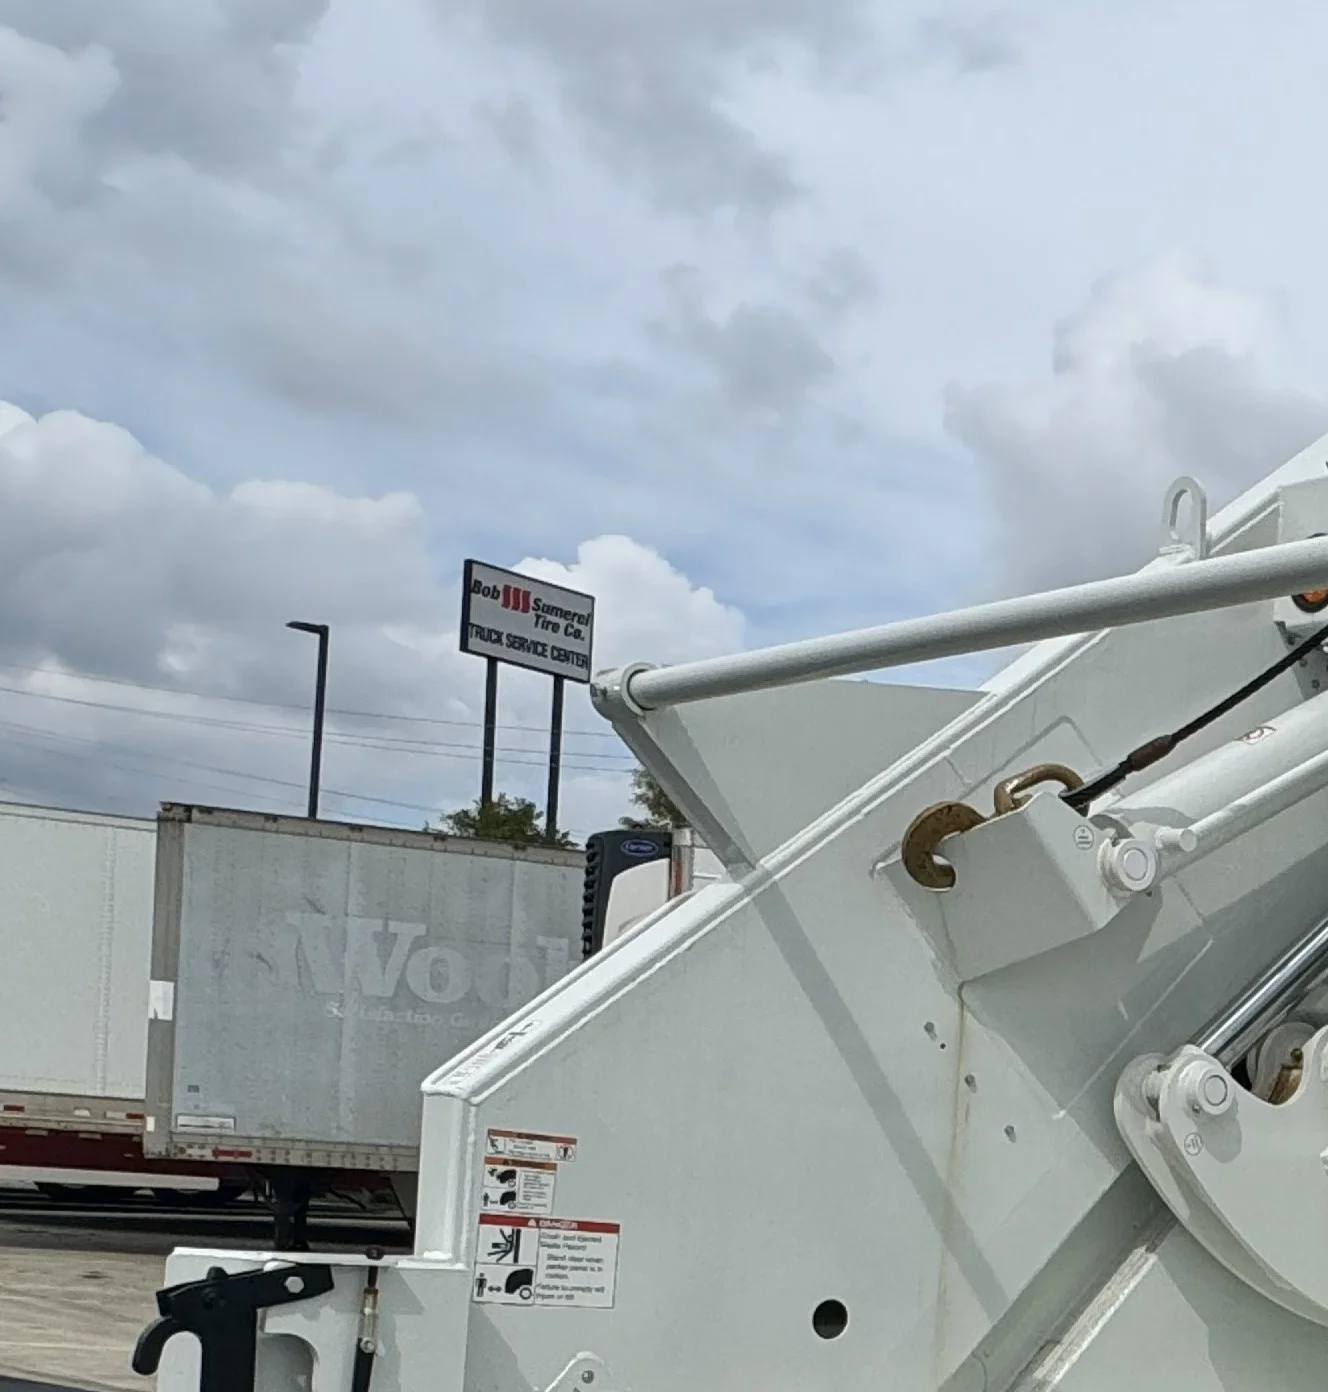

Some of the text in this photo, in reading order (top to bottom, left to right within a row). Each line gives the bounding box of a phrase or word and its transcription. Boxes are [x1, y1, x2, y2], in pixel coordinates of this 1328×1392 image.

[471, 579, 591, 627] Bob Sumerel
[468, 623, 589, 669] TRUCK SERVICE CENTER
[534, 614, 585, 641] Tire Co.
